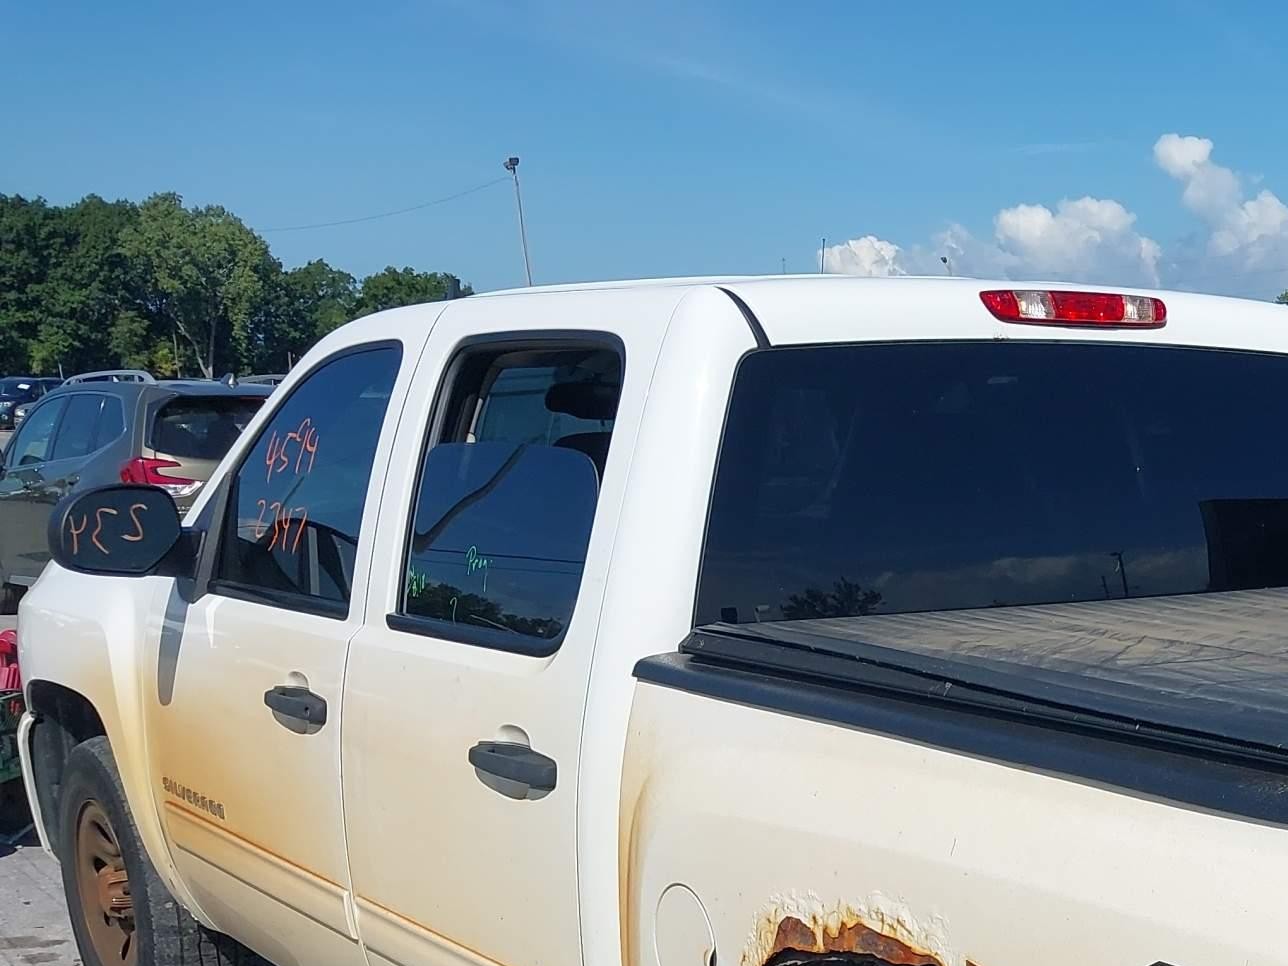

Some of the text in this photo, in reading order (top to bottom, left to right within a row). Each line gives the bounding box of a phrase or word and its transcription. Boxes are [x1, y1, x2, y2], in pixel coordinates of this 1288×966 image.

[266, 418, 320, 484] 4594
[255, 500, 308, 555] 2347
[162, 776, 225, 820] SILVERADO
